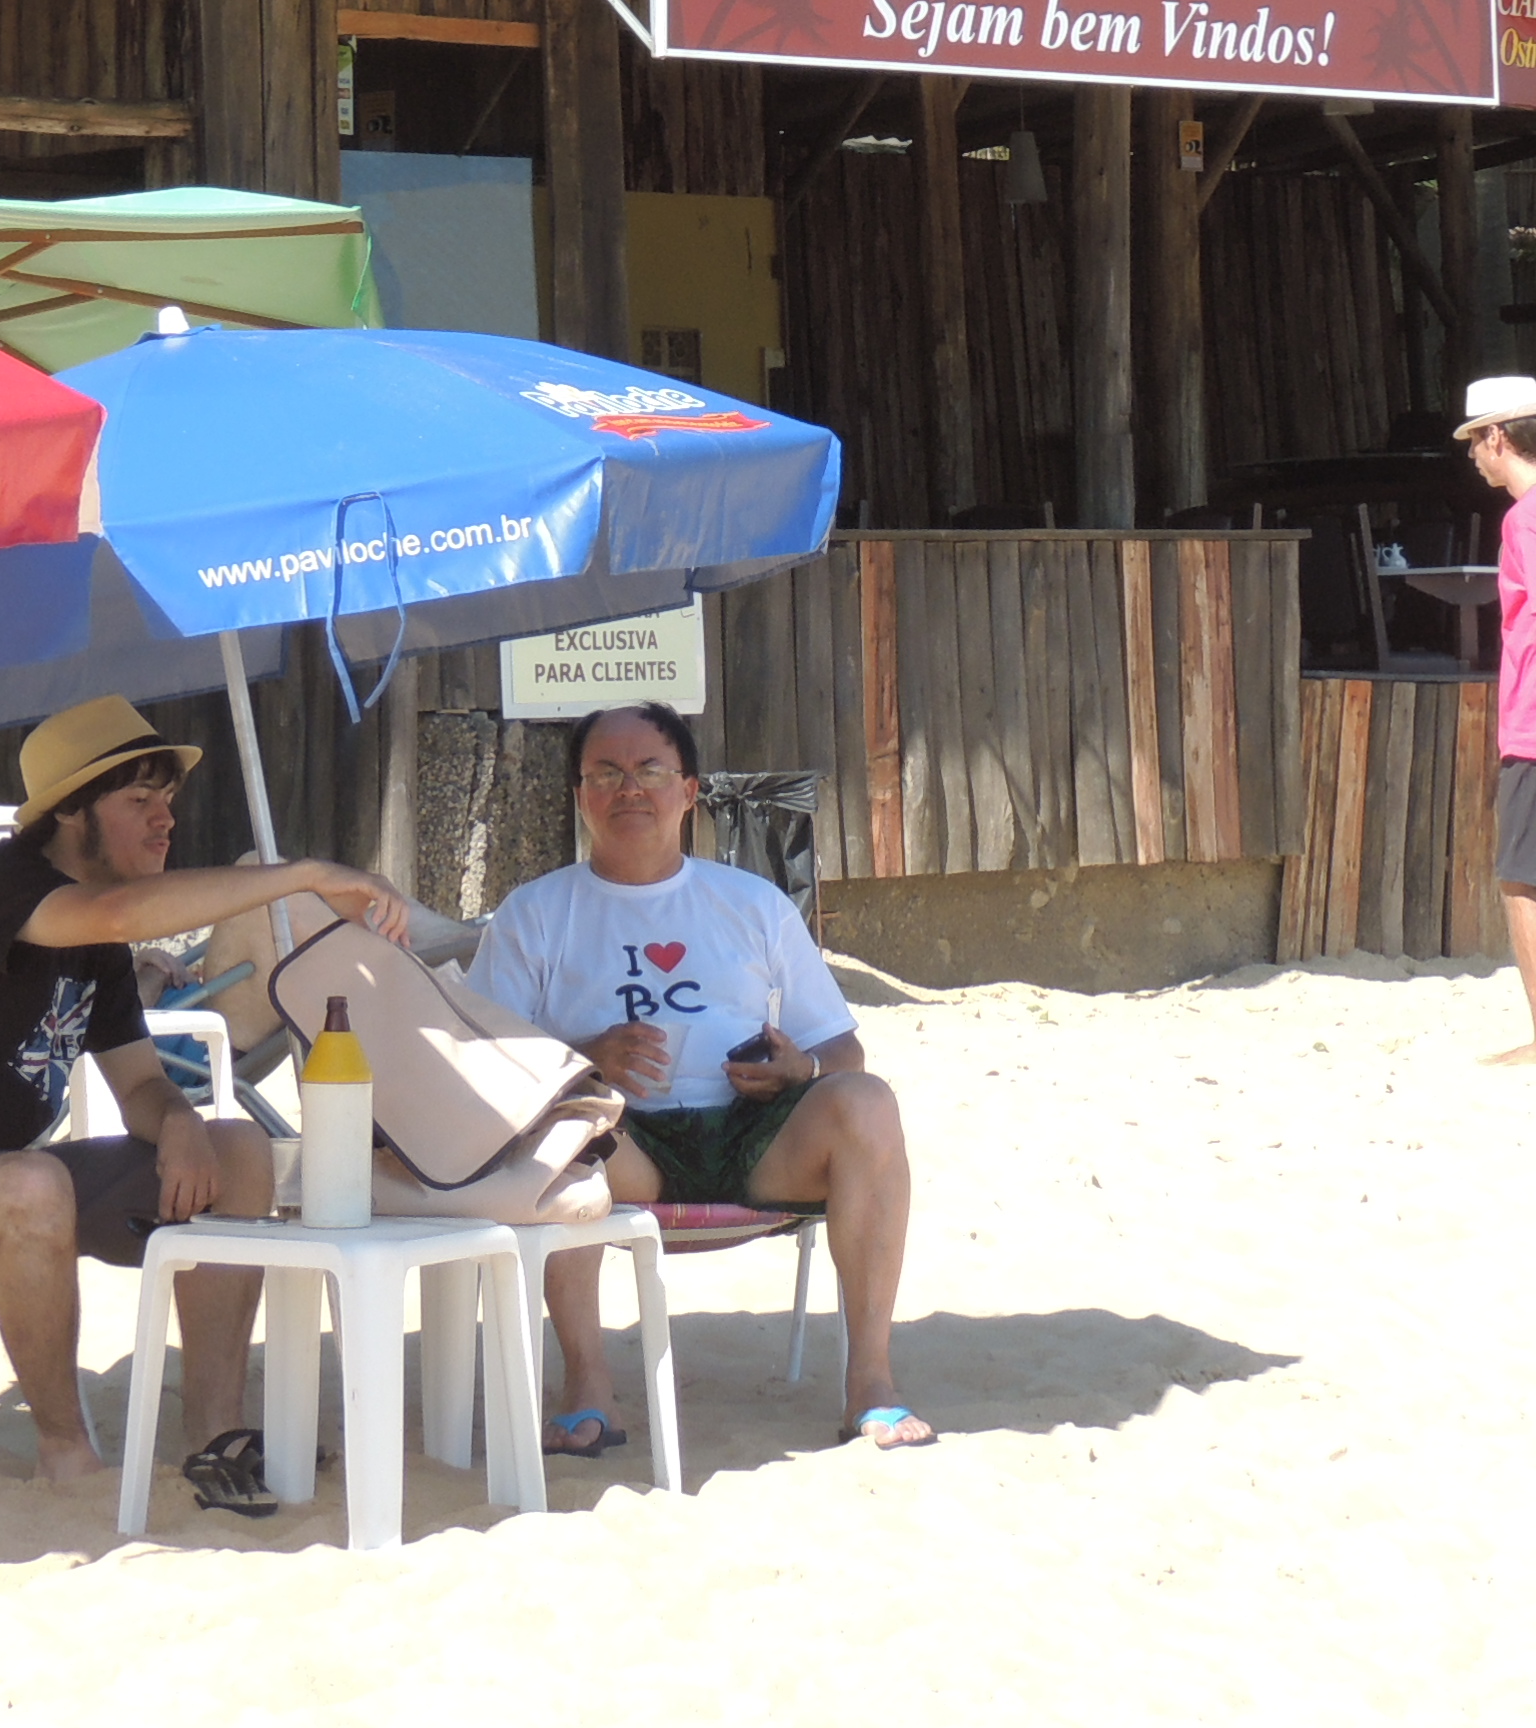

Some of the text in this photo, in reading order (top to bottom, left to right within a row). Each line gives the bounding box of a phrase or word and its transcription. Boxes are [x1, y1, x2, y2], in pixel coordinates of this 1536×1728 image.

[1161, 0, 1337, 67] Vindos!
[554, 629, 658, 651] EXCLUSIVA
[534, 660, 677, 683] PARA CLIENTES
[622, 945, 642, 977] I
[615, 980, 708, 1022] BC
